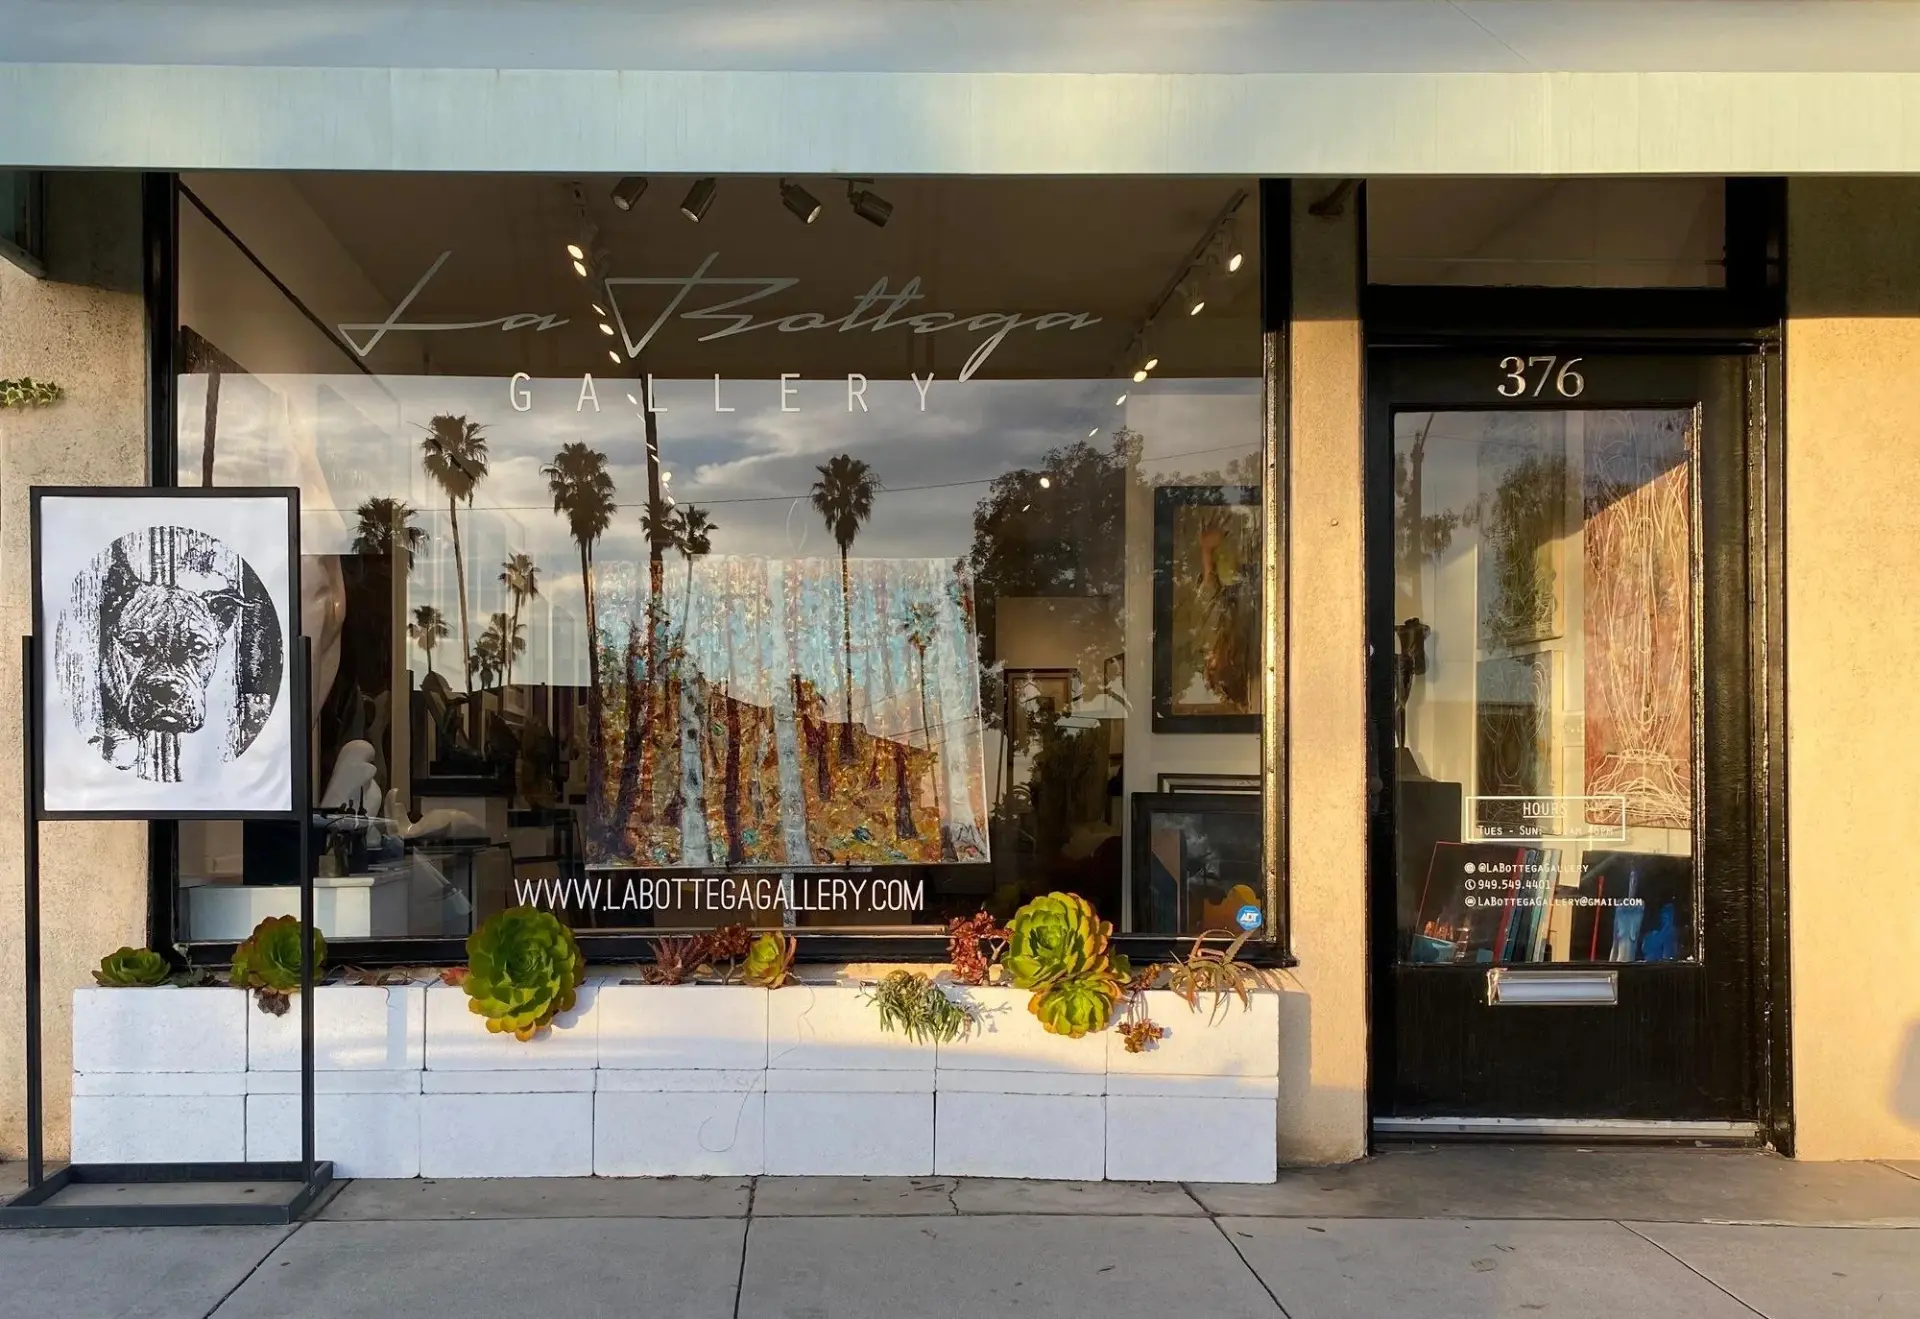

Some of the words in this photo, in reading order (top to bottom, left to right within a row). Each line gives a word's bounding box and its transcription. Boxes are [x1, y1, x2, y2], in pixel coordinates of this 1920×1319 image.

[336, 250, 571, 358] La
[604, 251, 1103, 383] Bottega
[508, 371, 937, 413] GALLERY
[1497, 355, 1585, 397] 376
[1522, 801, 1568, 816] HOURS
[513, 878, 925, 912] WWW.LABOTTEGAGALLERY.COM
[1478, 879, 1552, 891] 949.549.4401
[1240, 912, 1259, 922] ADT
